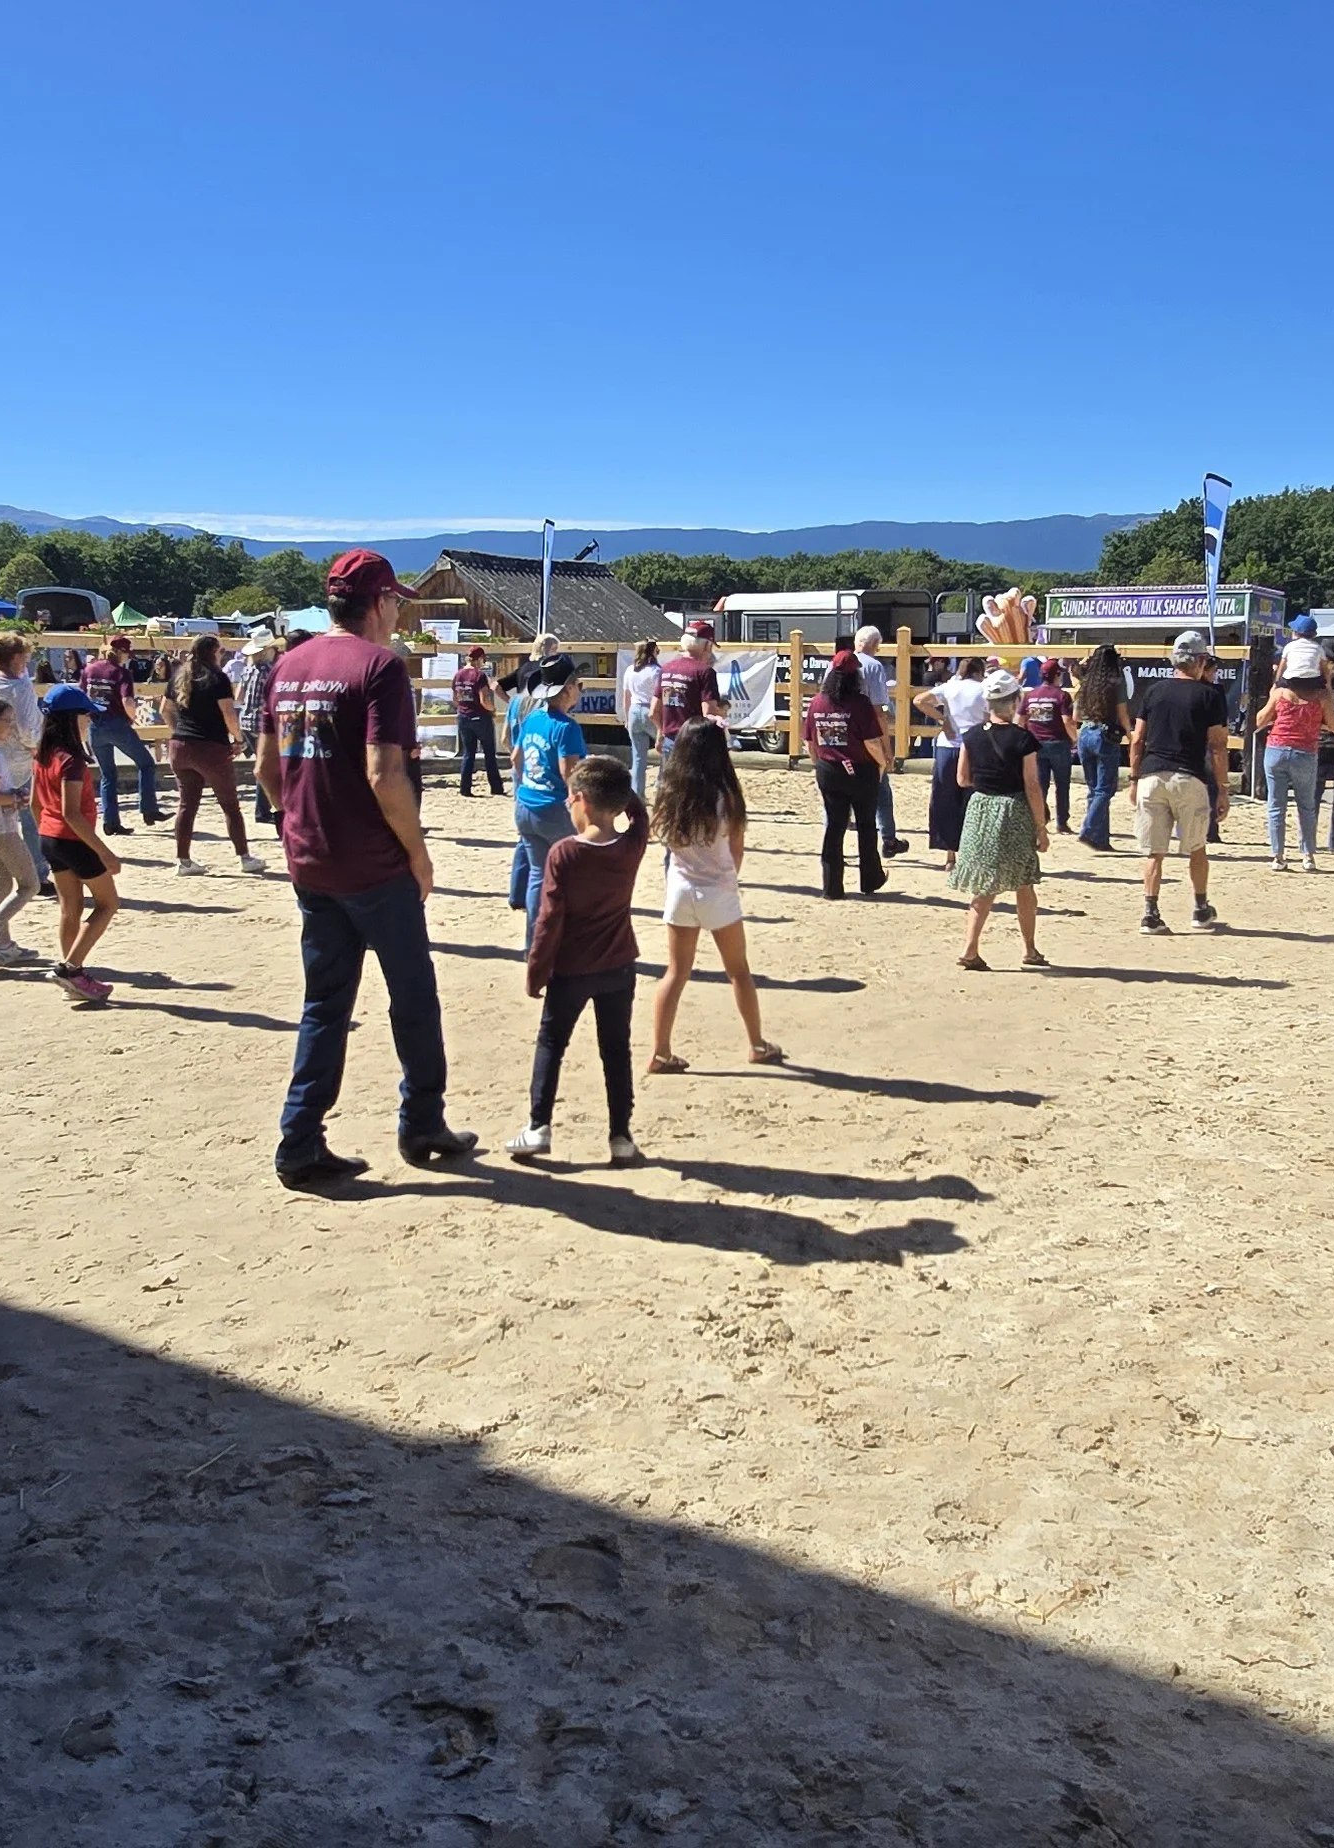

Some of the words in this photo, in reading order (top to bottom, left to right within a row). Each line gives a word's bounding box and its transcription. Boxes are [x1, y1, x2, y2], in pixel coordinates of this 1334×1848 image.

[1061, 599, 1094, 616] SUNDAE
[1095, 599, 1137, 616] CHURROS
[1140, 599, 1162, 615] MILK
[1163, 598, 1194, 615] SHAKE
[1195, 598, 1236, 615] GRNITA
[581, 694, 616, 713] HYPO
